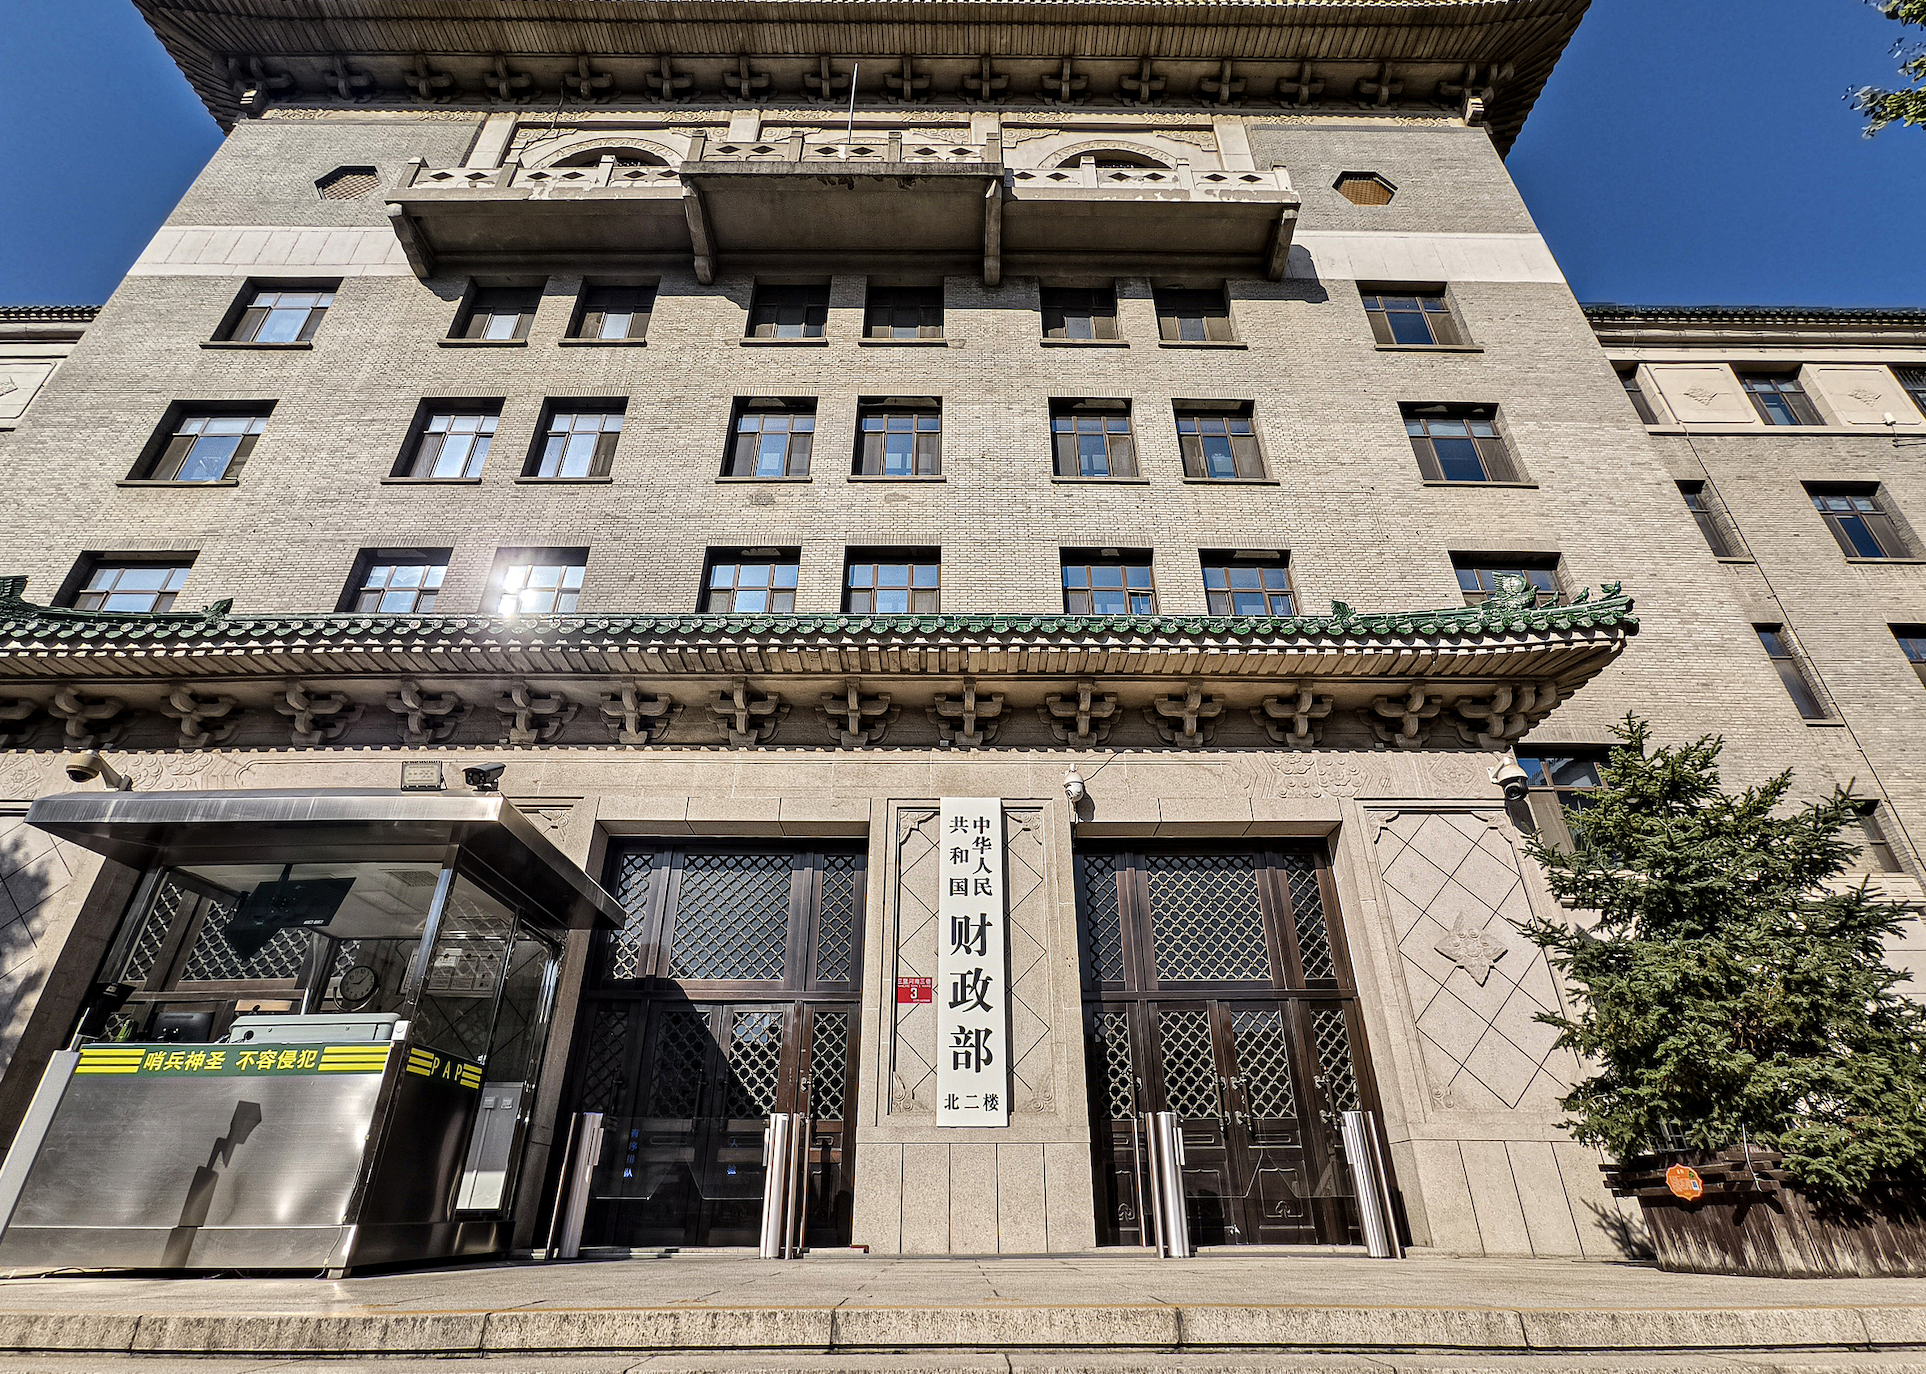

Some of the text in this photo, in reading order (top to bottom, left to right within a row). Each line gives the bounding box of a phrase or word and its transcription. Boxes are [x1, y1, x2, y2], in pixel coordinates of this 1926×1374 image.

[949, 816, 969, 897] 共和国
[972, 816, 993, 897] 中华人民
[910, 987, 918, 999] 3
[948, 912, 994, 1074] 财政部
[143, 1050, 225, 1072] 哨兵神圣
[235, 1049, 319, 1071] 不容侵犯
[944, 1093, 999, 1112] 北二楼
